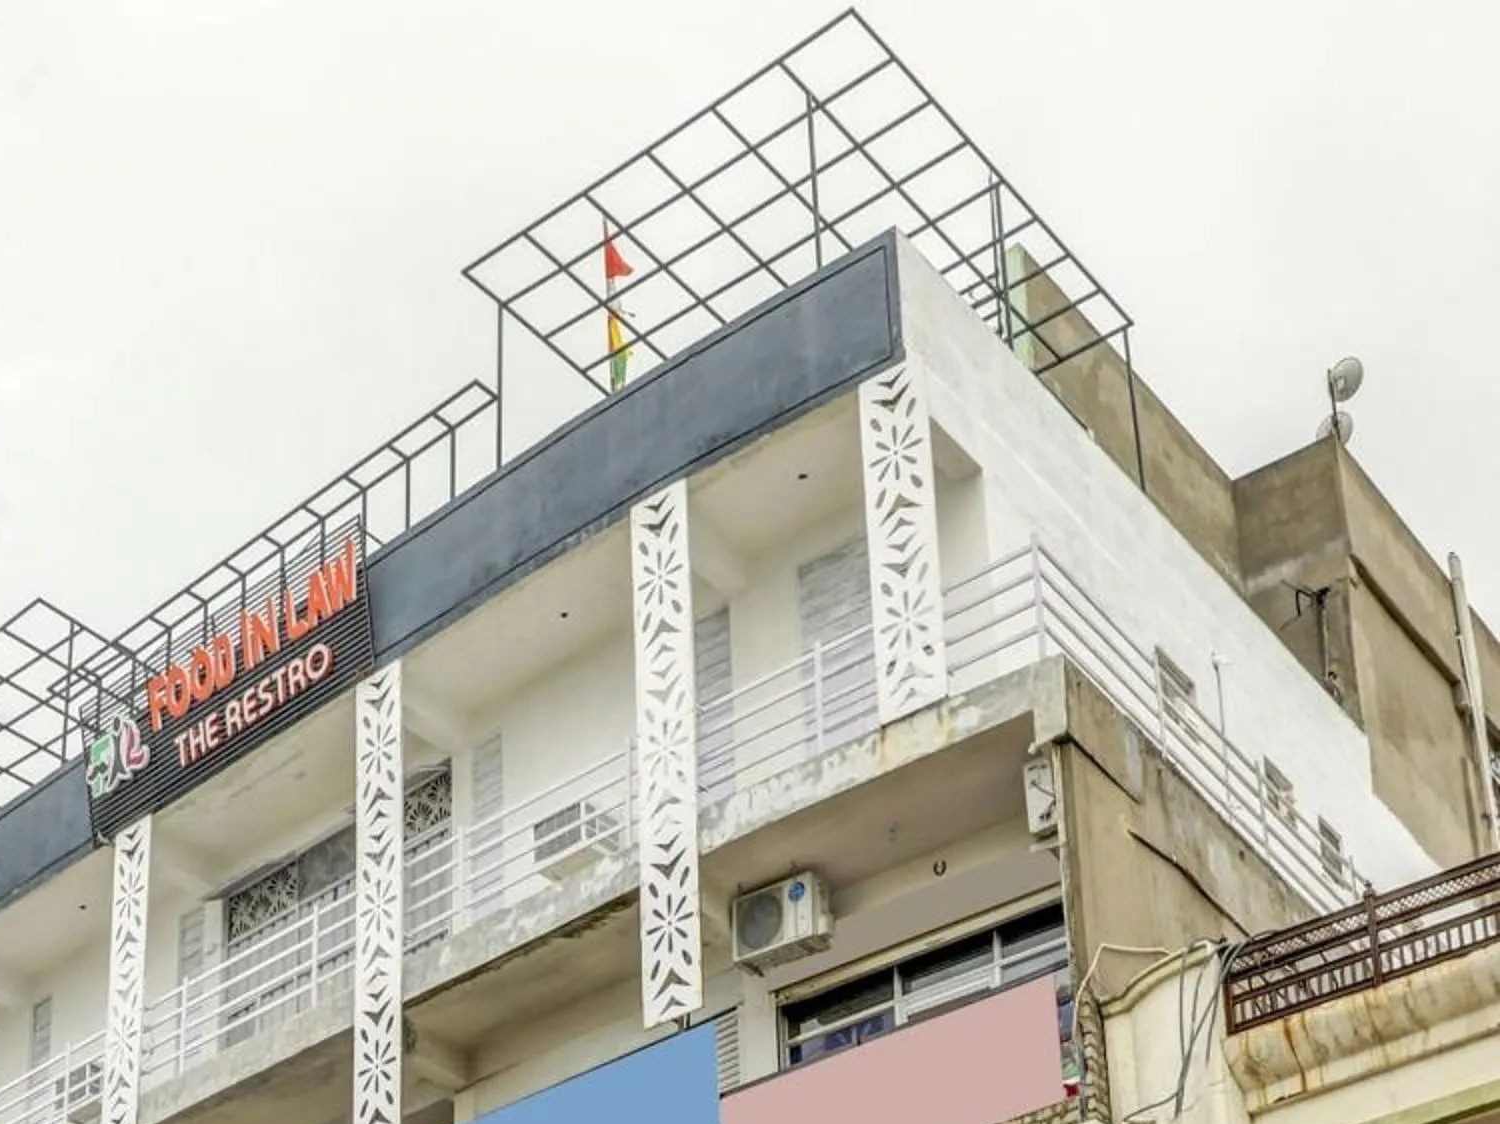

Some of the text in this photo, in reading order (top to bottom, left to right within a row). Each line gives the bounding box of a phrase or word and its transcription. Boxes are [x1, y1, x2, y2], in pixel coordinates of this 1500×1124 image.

[146, 537, 357, 733] FOOD IN LAW
[174, 643, 335, 767] THE RESTRO
